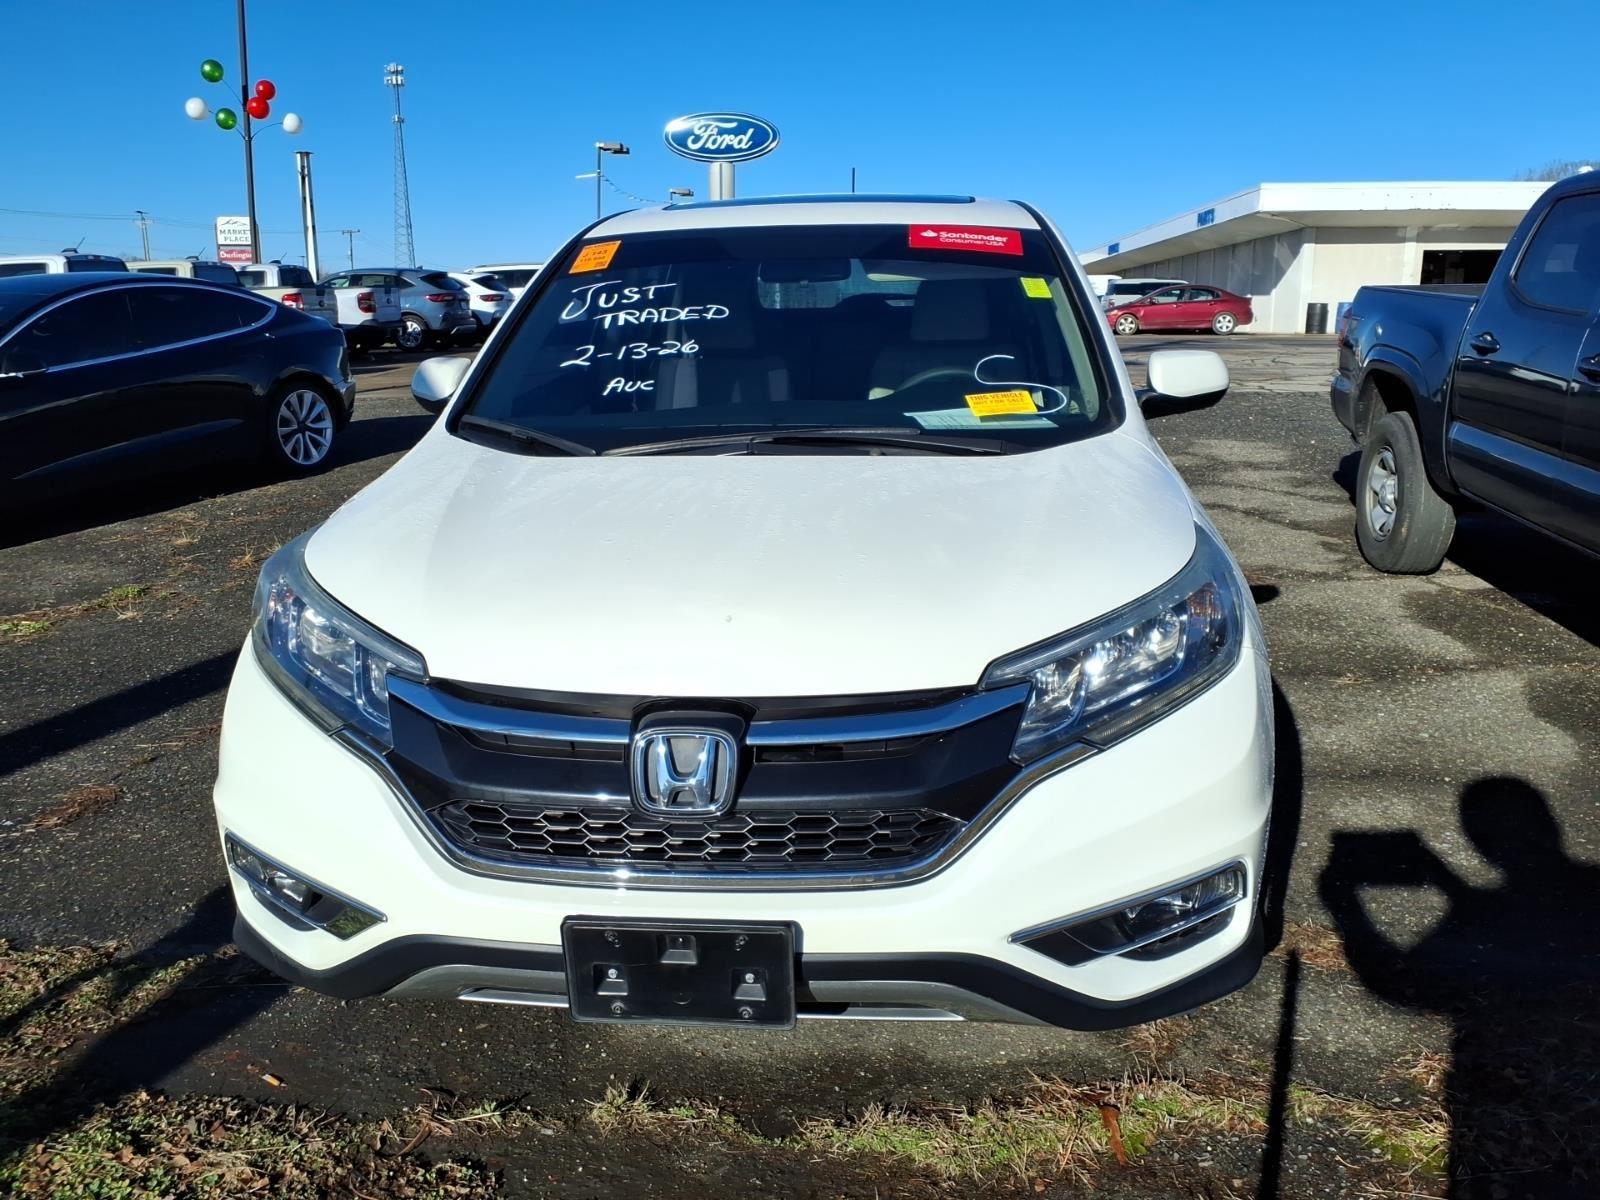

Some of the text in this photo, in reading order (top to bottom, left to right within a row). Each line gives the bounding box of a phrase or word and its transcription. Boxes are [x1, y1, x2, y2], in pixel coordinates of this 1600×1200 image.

[687, 119, 755, 150] Ford
[939, 231, 1008, 242] Santander
[939, 237, 985, 245] Consumer
[220, 250, 252, 260] Burlingto
[561, 280, 677, 320] JUST
[593, 304, 729, 329] TRADED
[559, 339, 699, 367] 2-13-26
